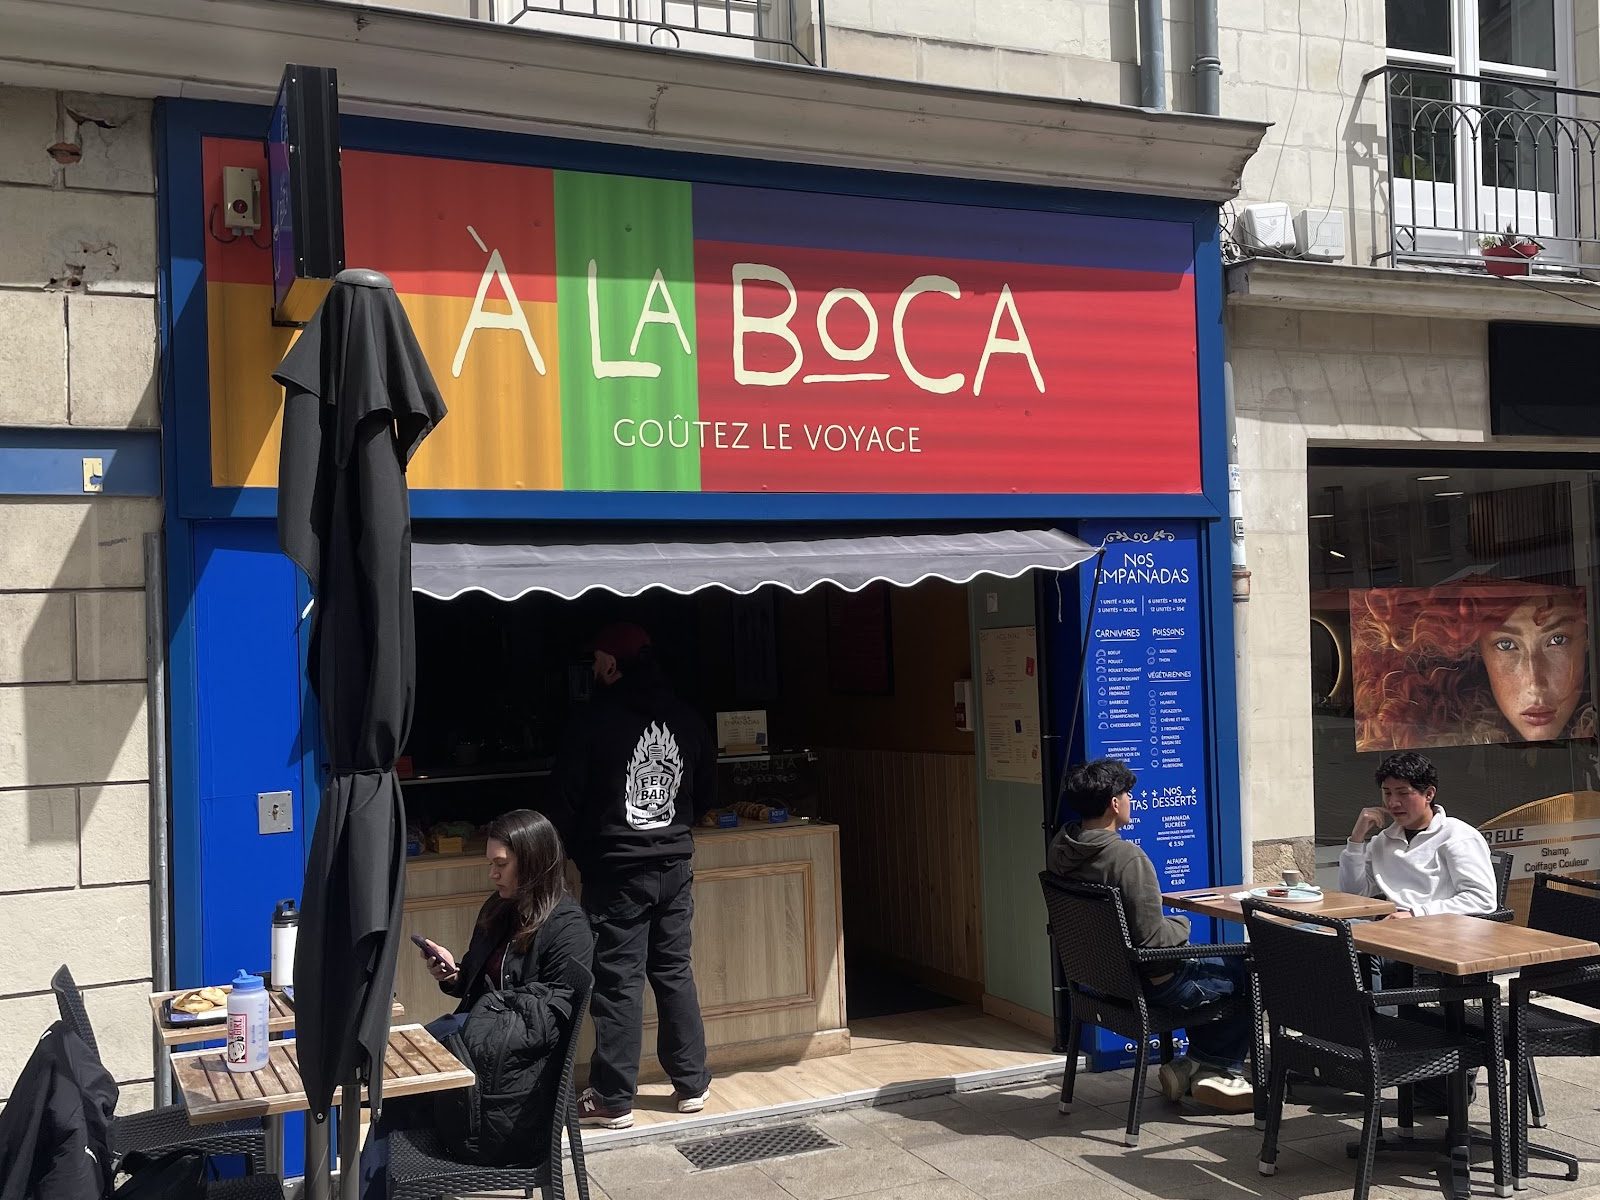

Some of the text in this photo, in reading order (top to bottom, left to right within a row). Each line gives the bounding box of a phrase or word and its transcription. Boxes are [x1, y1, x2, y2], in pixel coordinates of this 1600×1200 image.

[451, 225, 547, 379] À
[587, 258, 692, 380] LA
[613, 413, 922, 454] GOÛTEZ LE VOYAGE
[1124, 553, 1154, 567] NOS
[1095, 629, 1140, 638] CARNIVORES
[1152, 628, 1185, 636] POISSONS
[1147, 670, 1191, 679] VÉGÉTARIENNES
[640, 776, 669, 788] FEU
[641, 789, 665, 800] BAR
[1163, 786, 1182, 796] NOS
[1152, 795, 1197, 808] DESSERTS
[1496, 828, 1524, 843] ELLE
[1524, 858, 1589, 872] Coiffage Couleur
[233, 1018, 242, 1036] GIRL
